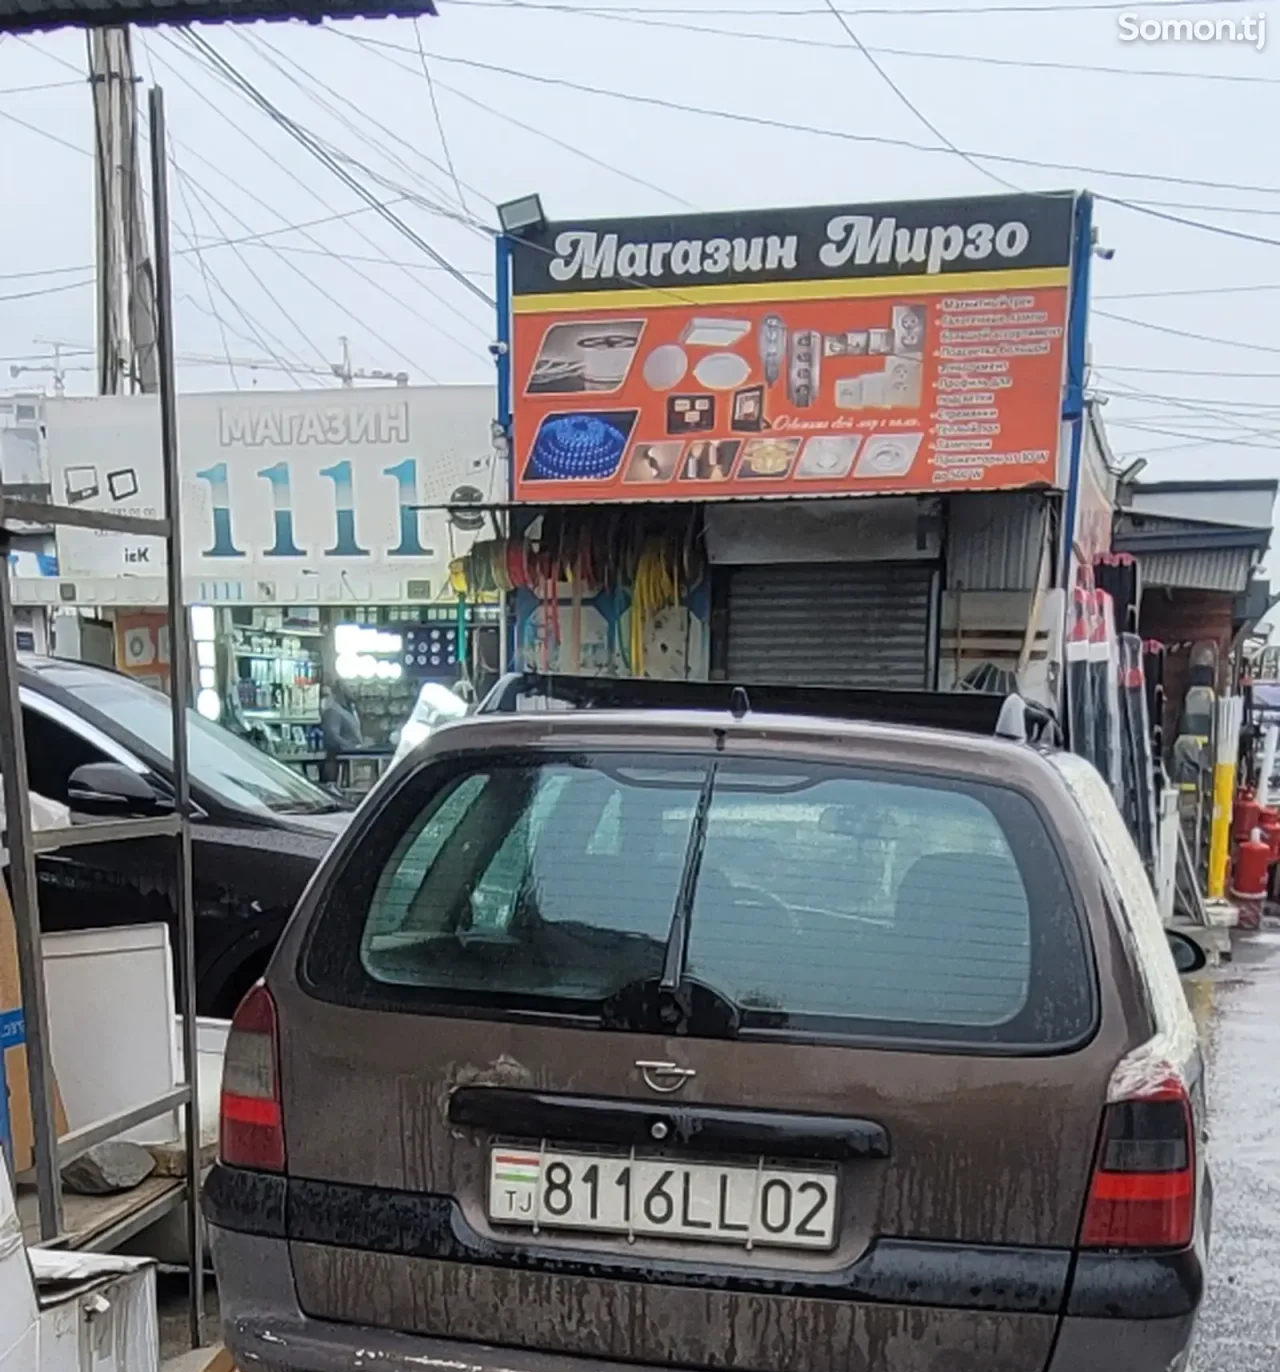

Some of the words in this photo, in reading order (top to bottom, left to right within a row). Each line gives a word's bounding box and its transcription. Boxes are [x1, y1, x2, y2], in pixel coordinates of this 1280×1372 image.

[549, 231, 797, 282] Магазин
[819, 215, 1029, 273] Мирзо
[219, 402, 409, 446] МАГАЗИН
[197, 459, 434, 557] 1111
[505, 1190, 532, 1213] TJ
